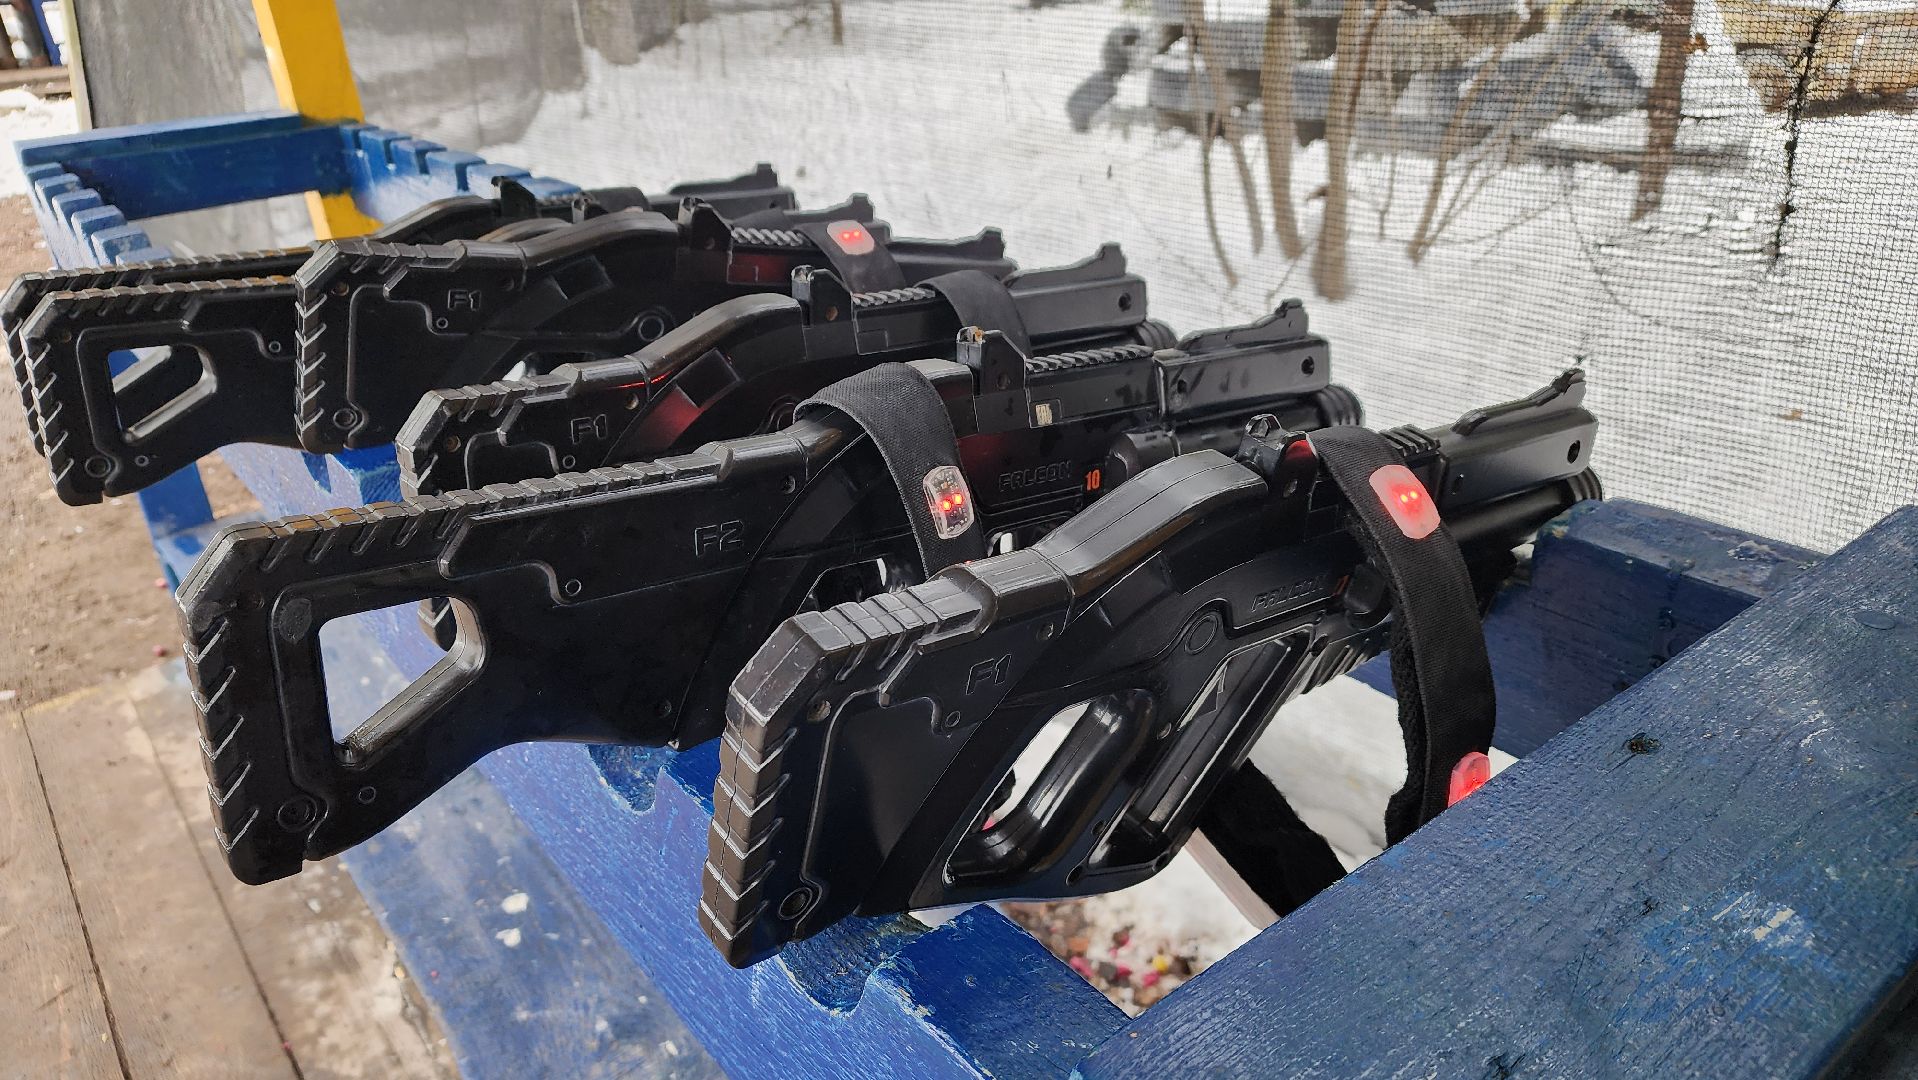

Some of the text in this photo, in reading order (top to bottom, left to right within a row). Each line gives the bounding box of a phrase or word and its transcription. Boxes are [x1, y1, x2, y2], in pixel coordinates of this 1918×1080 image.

[447, 289, 481, 311] F1
[570, 413, 608, 445] F1
[999, 460, 1101, 492] FALCON 10
[694, 519, 745, 558] F2
[965, 653, 1012, 696] F1
